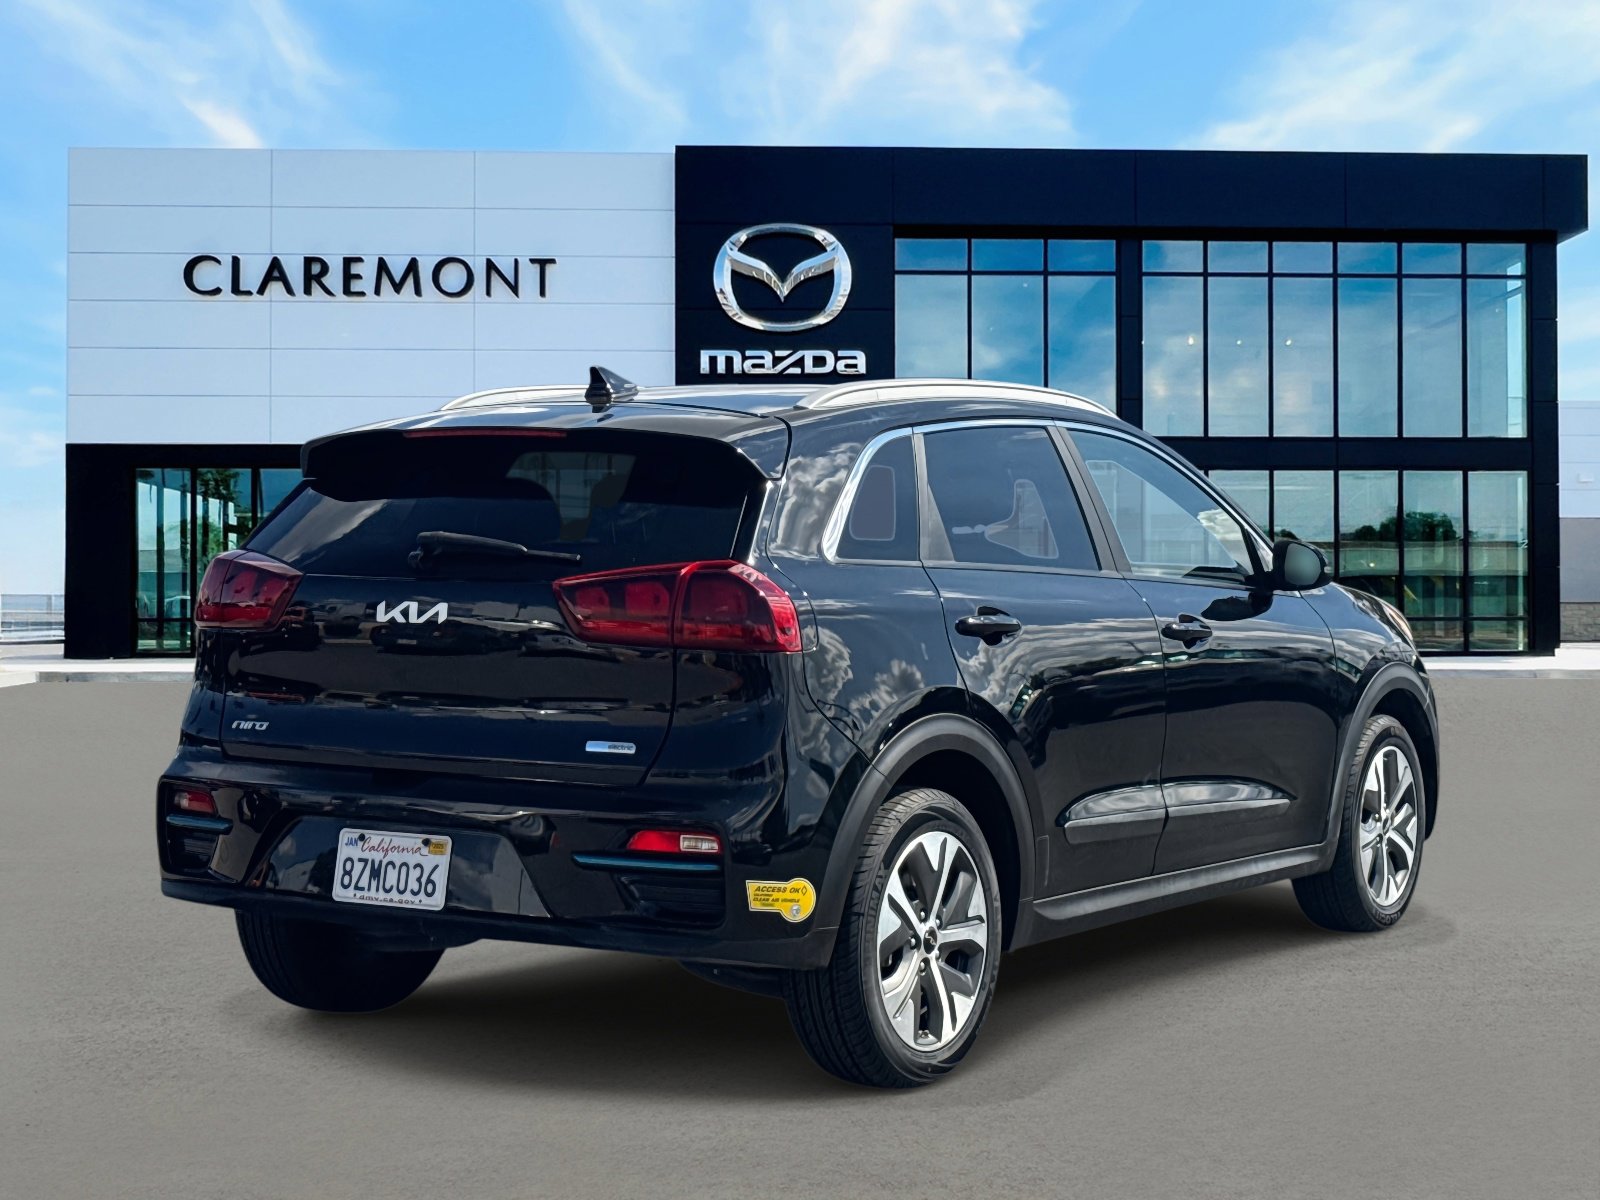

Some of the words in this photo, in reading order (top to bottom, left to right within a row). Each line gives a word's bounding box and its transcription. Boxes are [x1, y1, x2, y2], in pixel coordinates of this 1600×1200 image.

[183, 254, 557, 299] CLAREMONT
[376, 600, 449, 624] KIA
[345, 837, 359, 847] JAN
[361, 837, 428, 859] California
[340, 856, 440, 898] 8ZMC036
[359, 895, 415, 904] dmv.ca.gov
